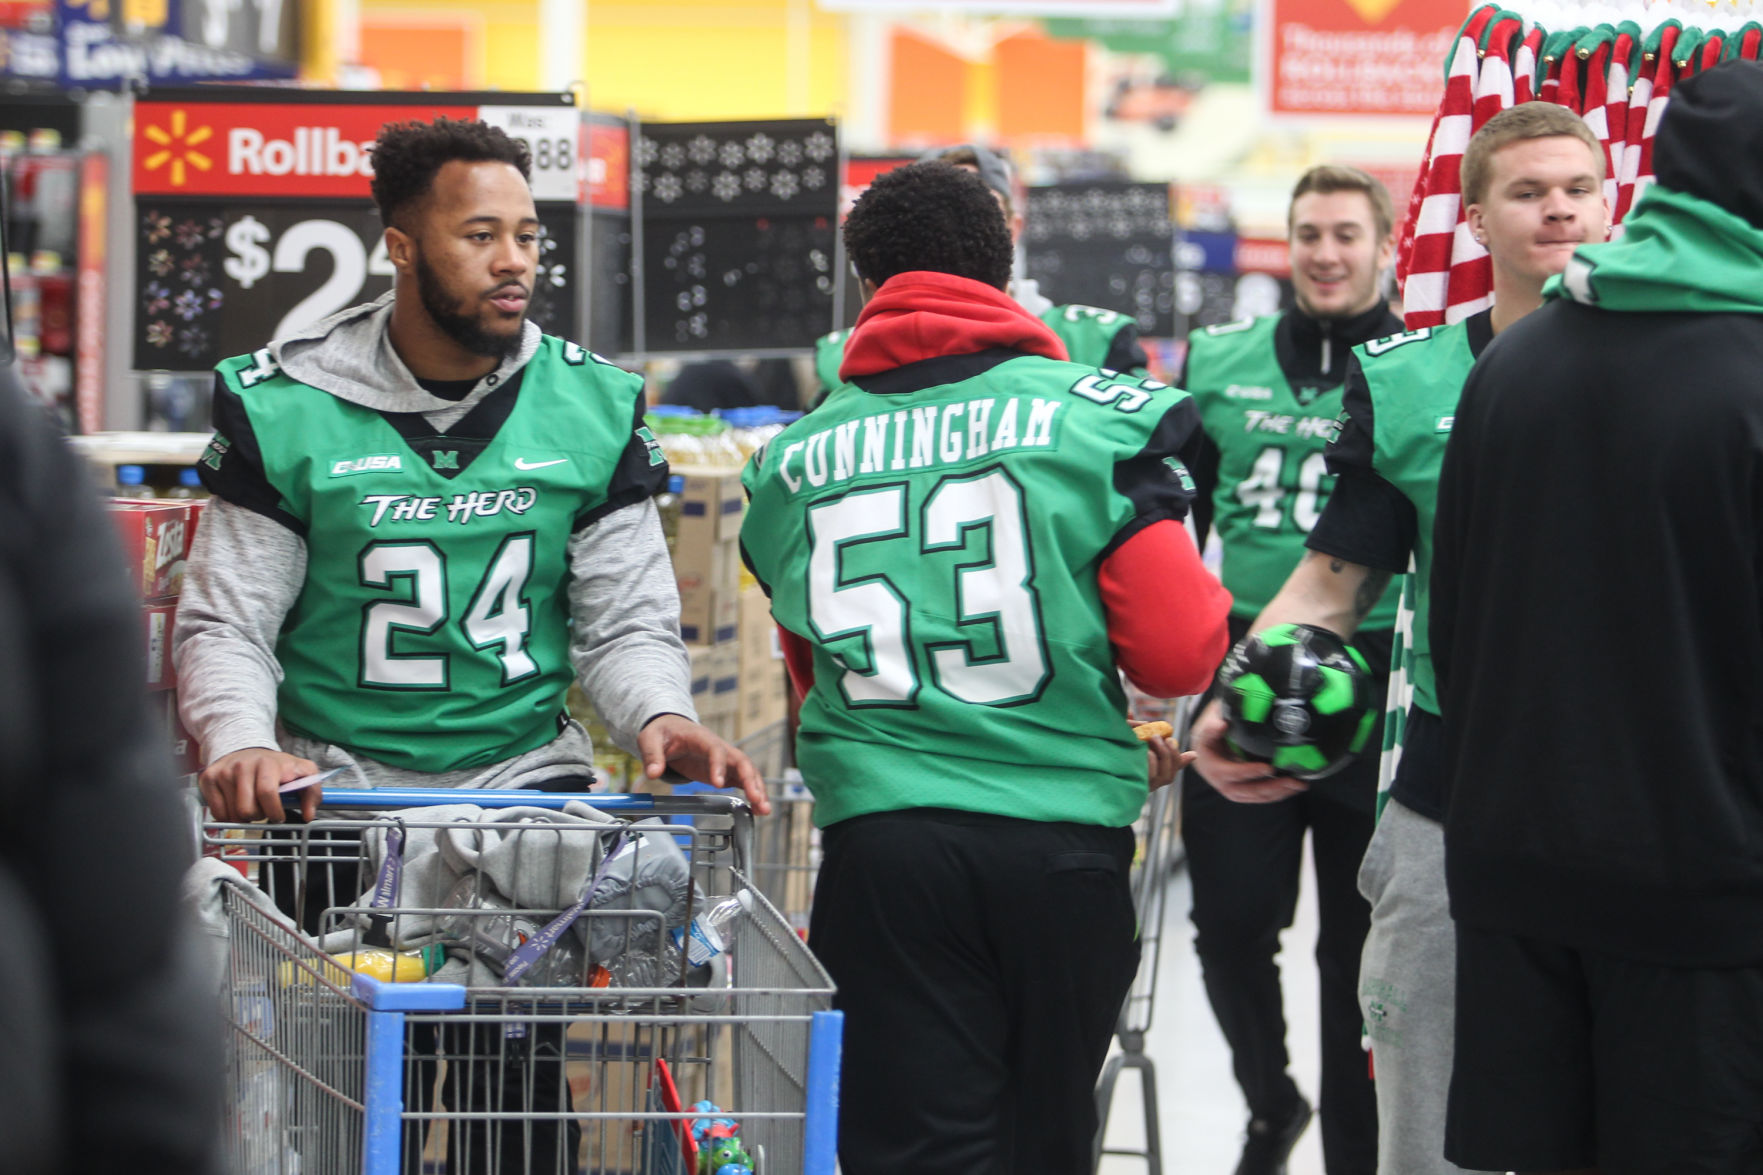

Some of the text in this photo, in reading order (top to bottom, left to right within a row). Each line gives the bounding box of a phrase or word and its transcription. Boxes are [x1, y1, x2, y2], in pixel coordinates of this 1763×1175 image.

[358, 486, 538, 527] THE HERD
[779, 397, 1061, 494] CUNNINGHAM
[357, 529, 541, 692] 24
[805, 462, 1055, 711] 53
